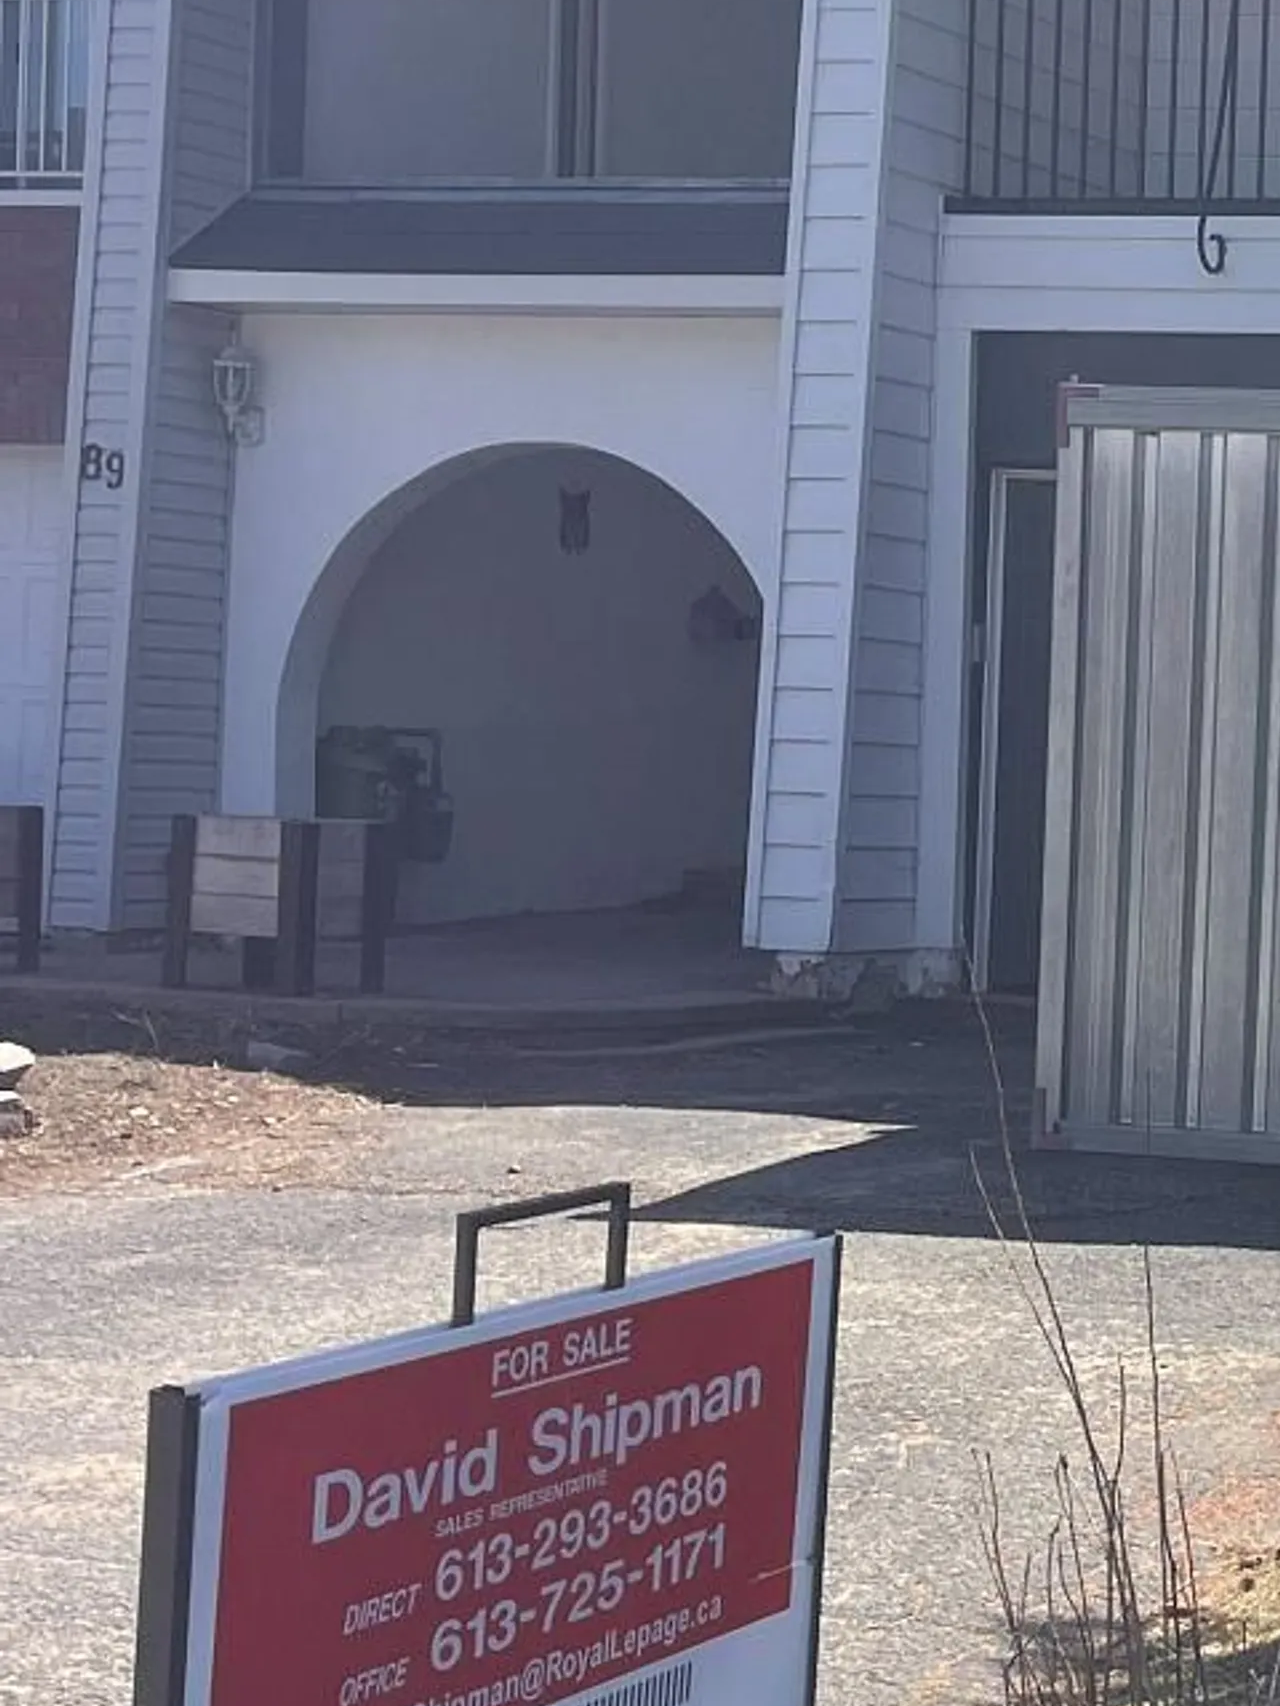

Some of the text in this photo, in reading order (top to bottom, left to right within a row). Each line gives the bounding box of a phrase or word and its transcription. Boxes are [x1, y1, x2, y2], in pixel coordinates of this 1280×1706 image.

[80, 443, 125, 490] 89
[492, 1319, 632, 1387] FOR SALE
[311, 1364, 762, 1543] David Shipman
[343, 1461, 727, 1634] DIRECT 613-293-3686
[433, 1509, 485, 1537] SALES
[431, 1524, 726, 1670] 613-725-1171
